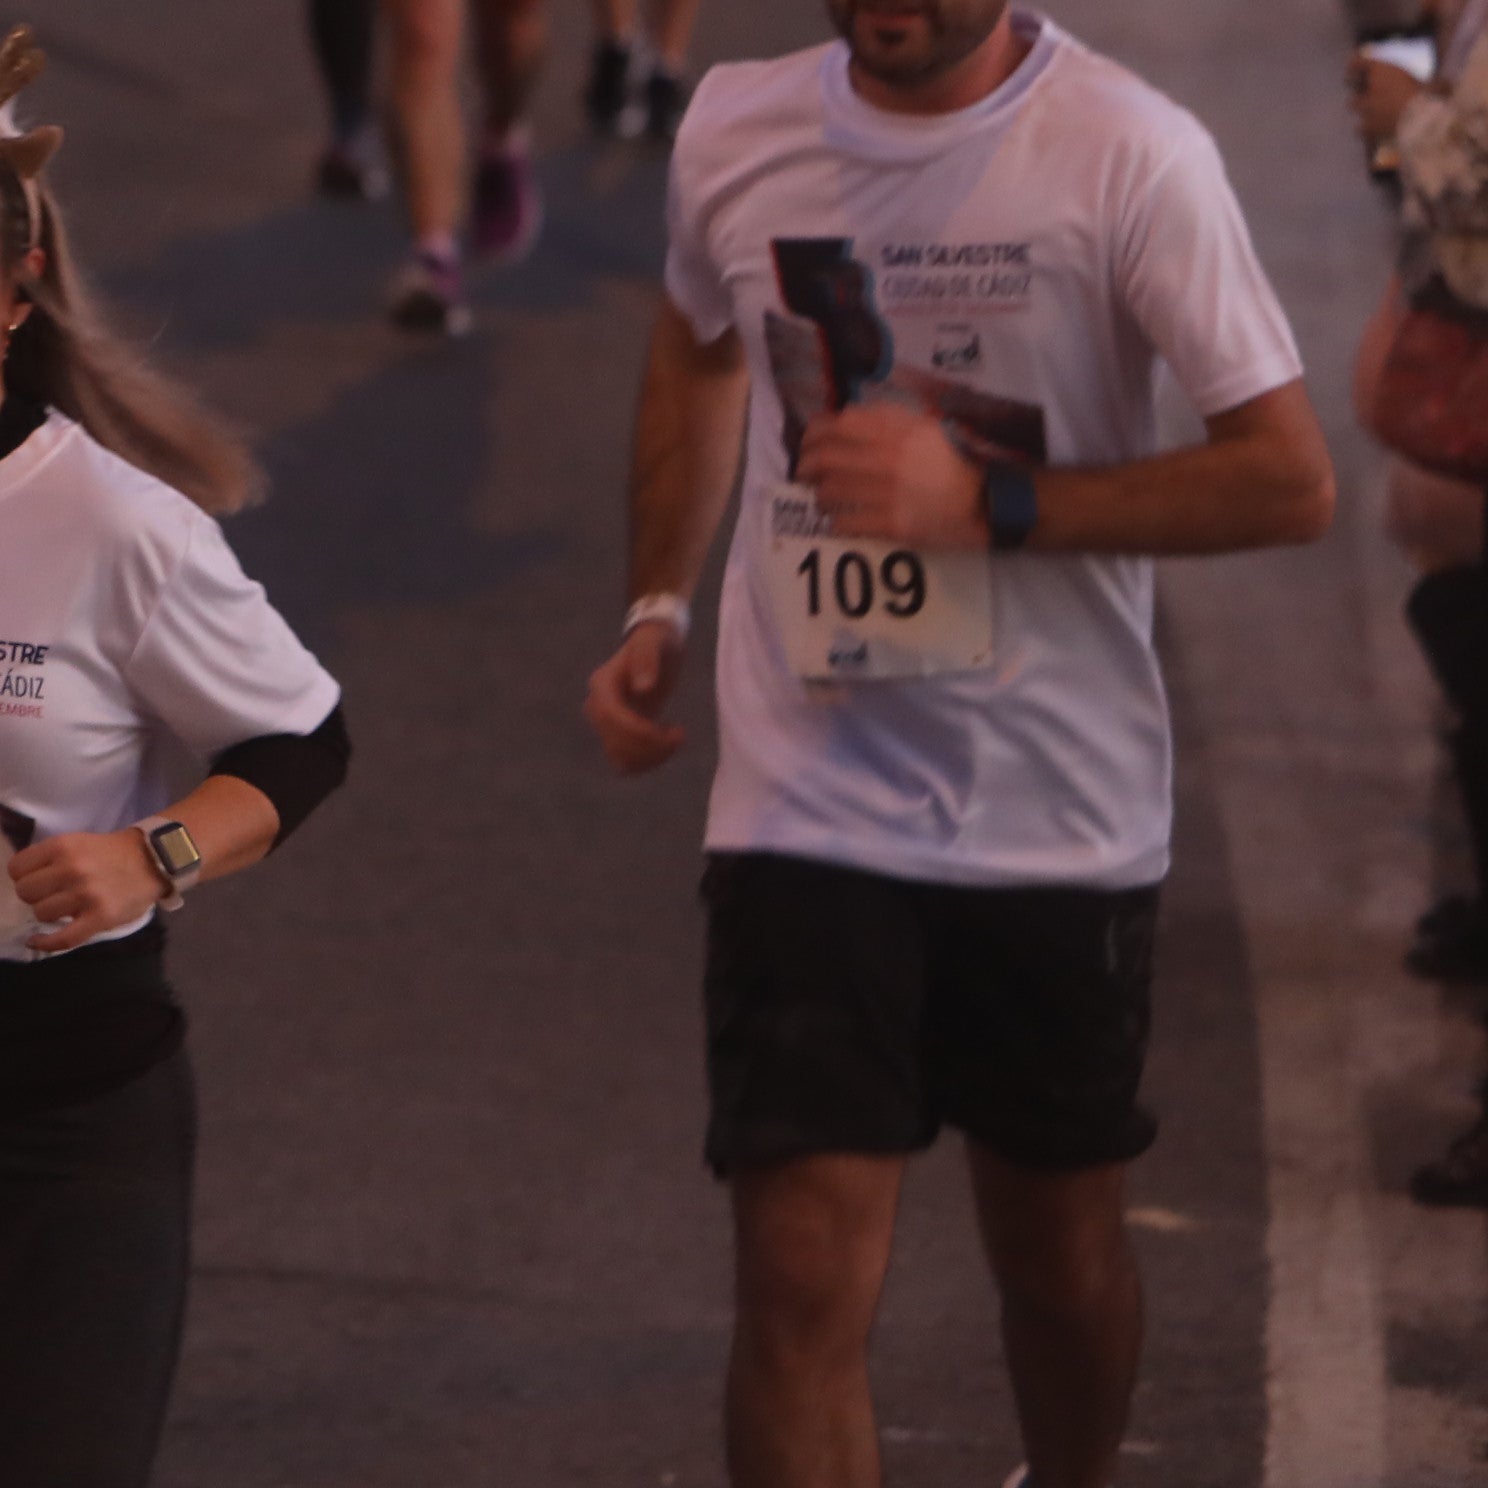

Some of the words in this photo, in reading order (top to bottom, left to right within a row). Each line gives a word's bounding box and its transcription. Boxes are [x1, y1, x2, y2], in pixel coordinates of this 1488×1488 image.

[882, 244, 923, 267] SAN
[927, 243, 1031, 267] SILVESTRE
[797, 549, 927, 620] 109
